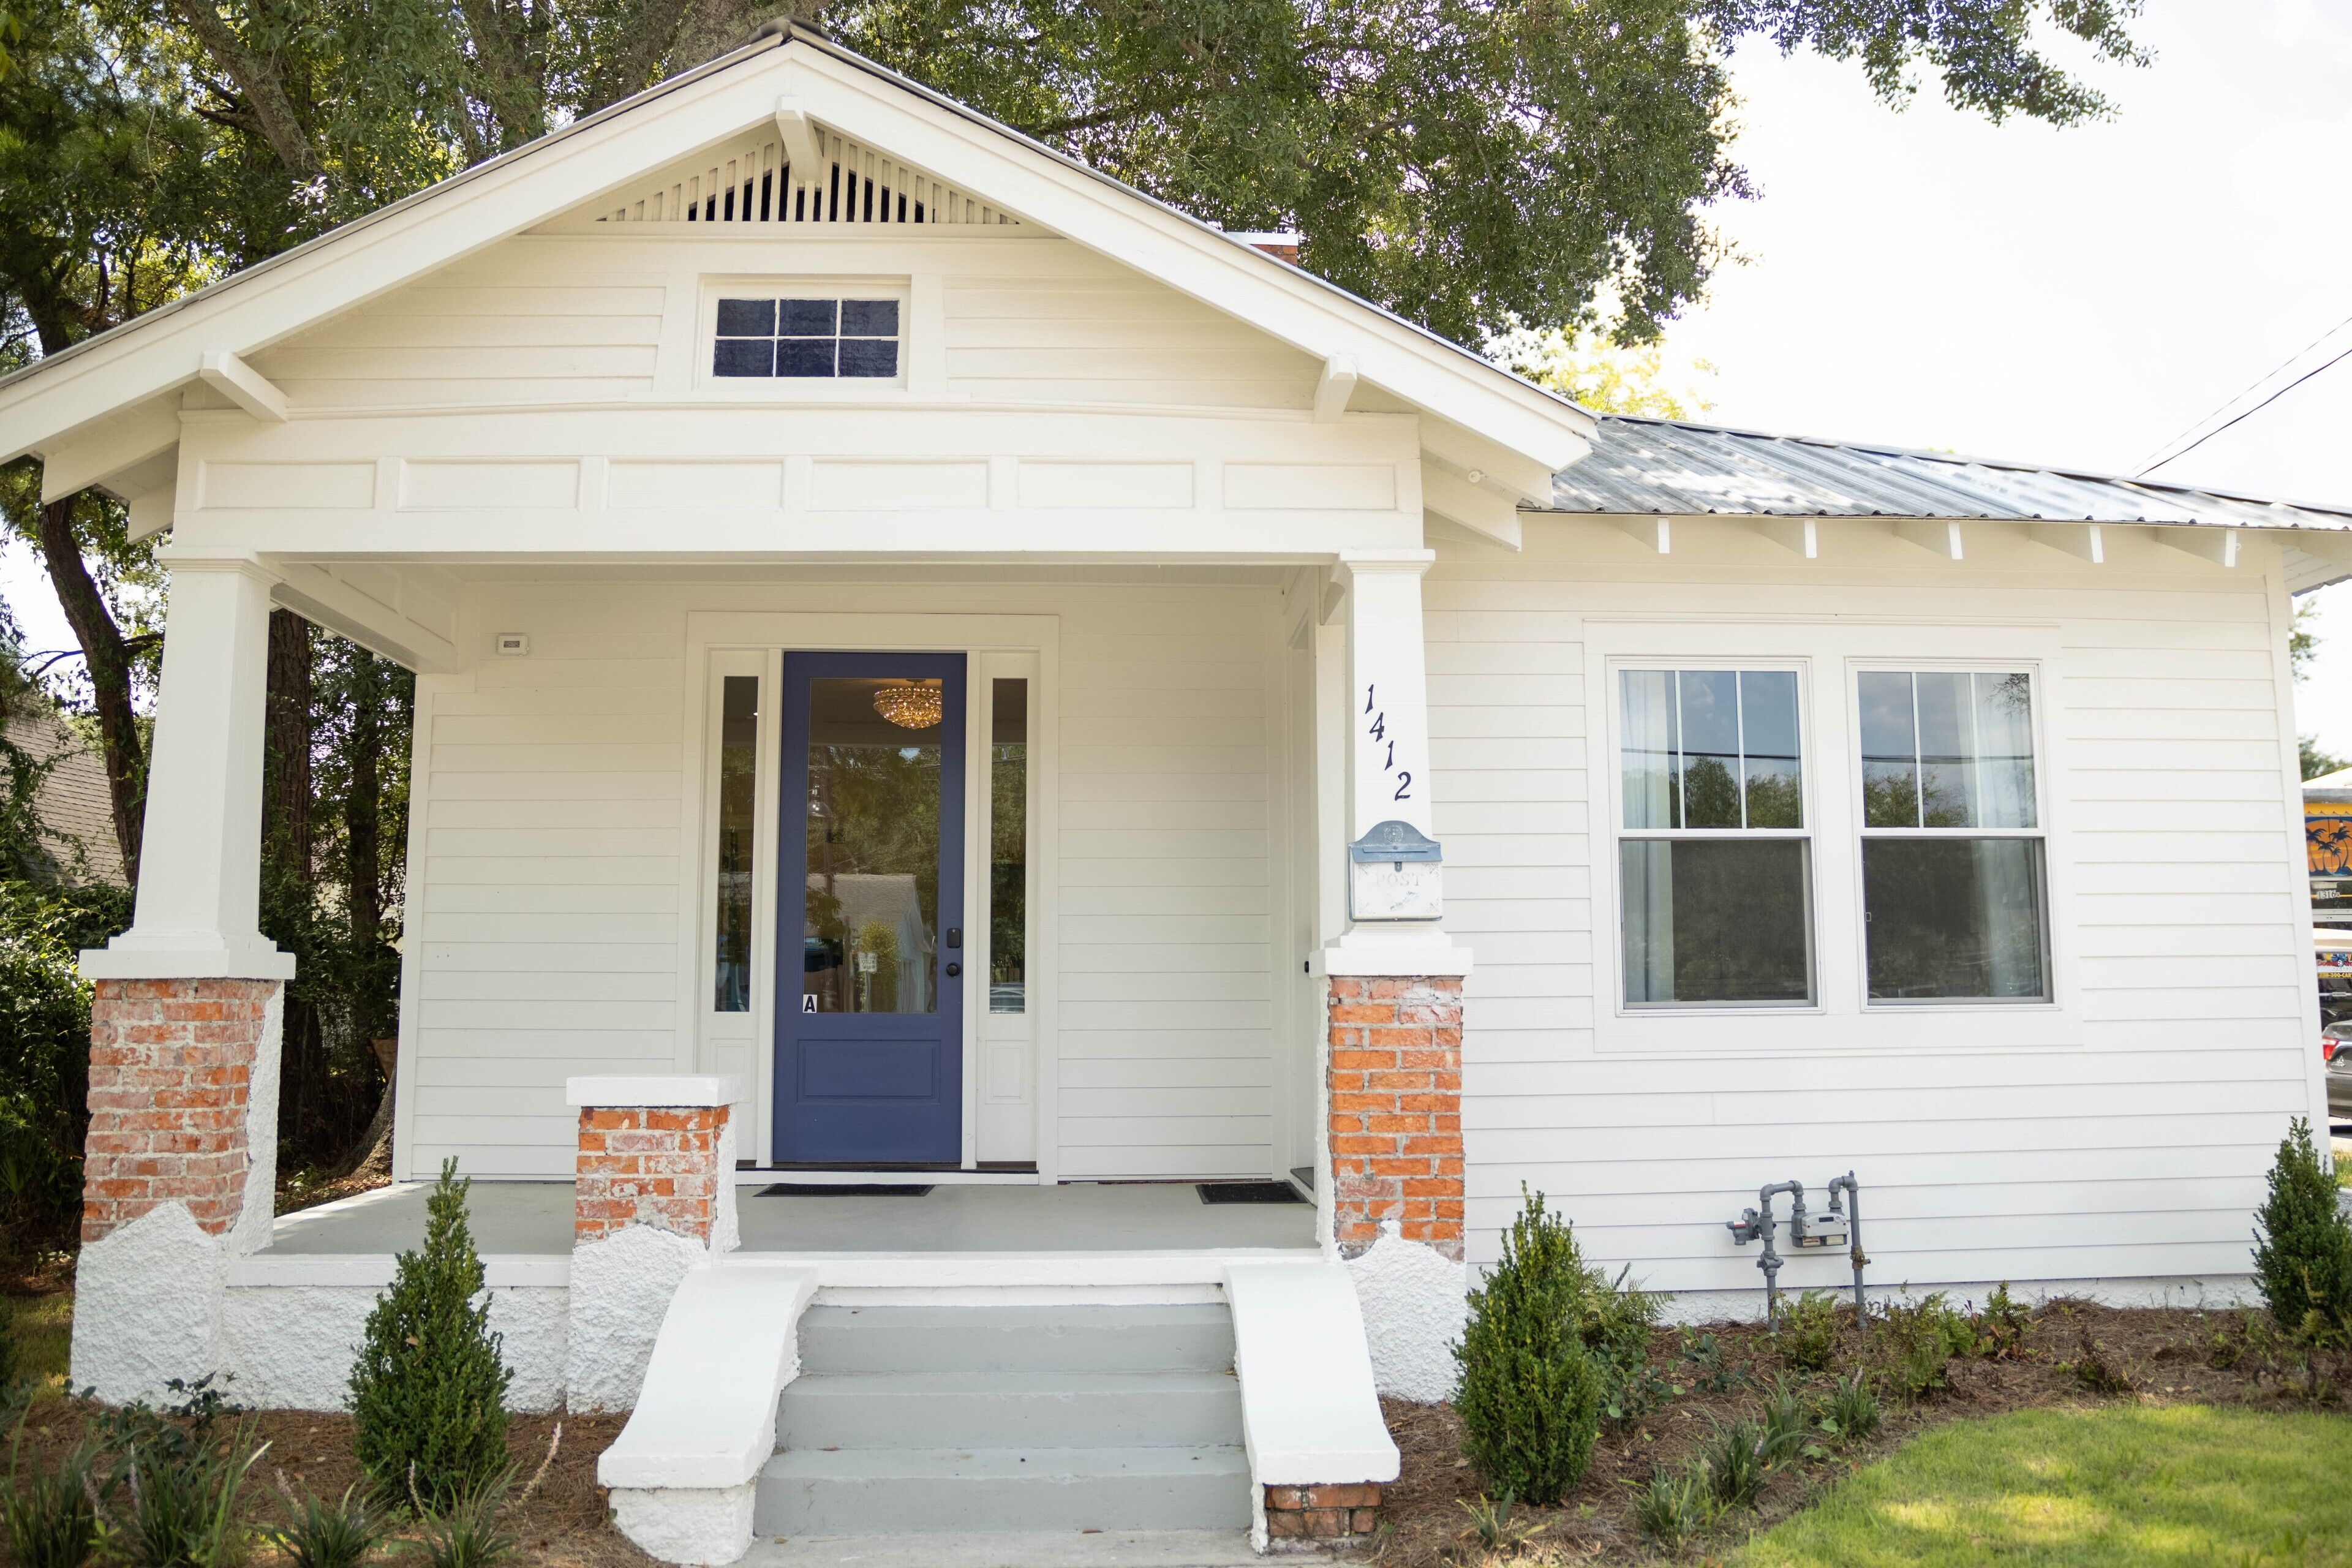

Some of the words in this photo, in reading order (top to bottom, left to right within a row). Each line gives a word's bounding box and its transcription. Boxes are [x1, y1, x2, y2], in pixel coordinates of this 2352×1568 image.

[1365, 684, 1411, 801] 1412
[1375, 872, 1424, 887] POST
[804, 995, 815, 1012] A
